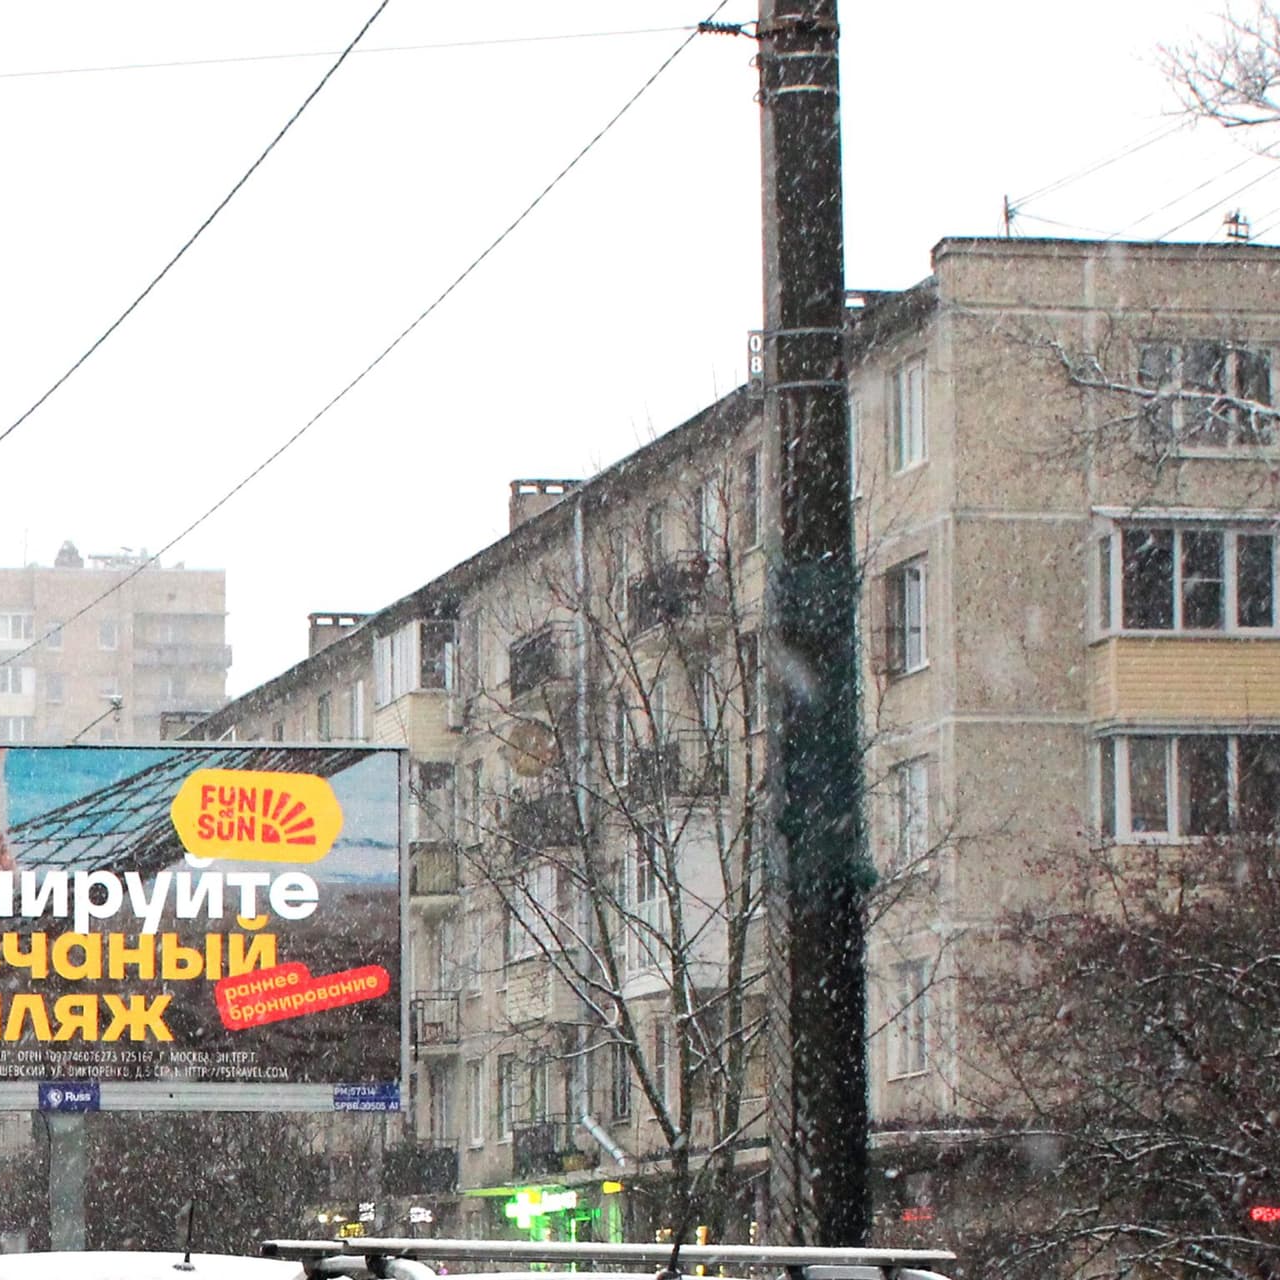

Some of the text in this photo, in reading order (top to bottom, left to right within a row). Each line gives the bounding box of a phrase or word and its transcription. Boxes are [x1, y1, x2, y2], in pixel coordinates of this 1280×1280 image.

[201, 785, 256, 813] FUN
[198, 814, 255, 842] SUN
[224, 972, 300, 1004] раннее
[228, 975, 378, 1021] бронирование
[65, 1091, 91, 1102] Russ
